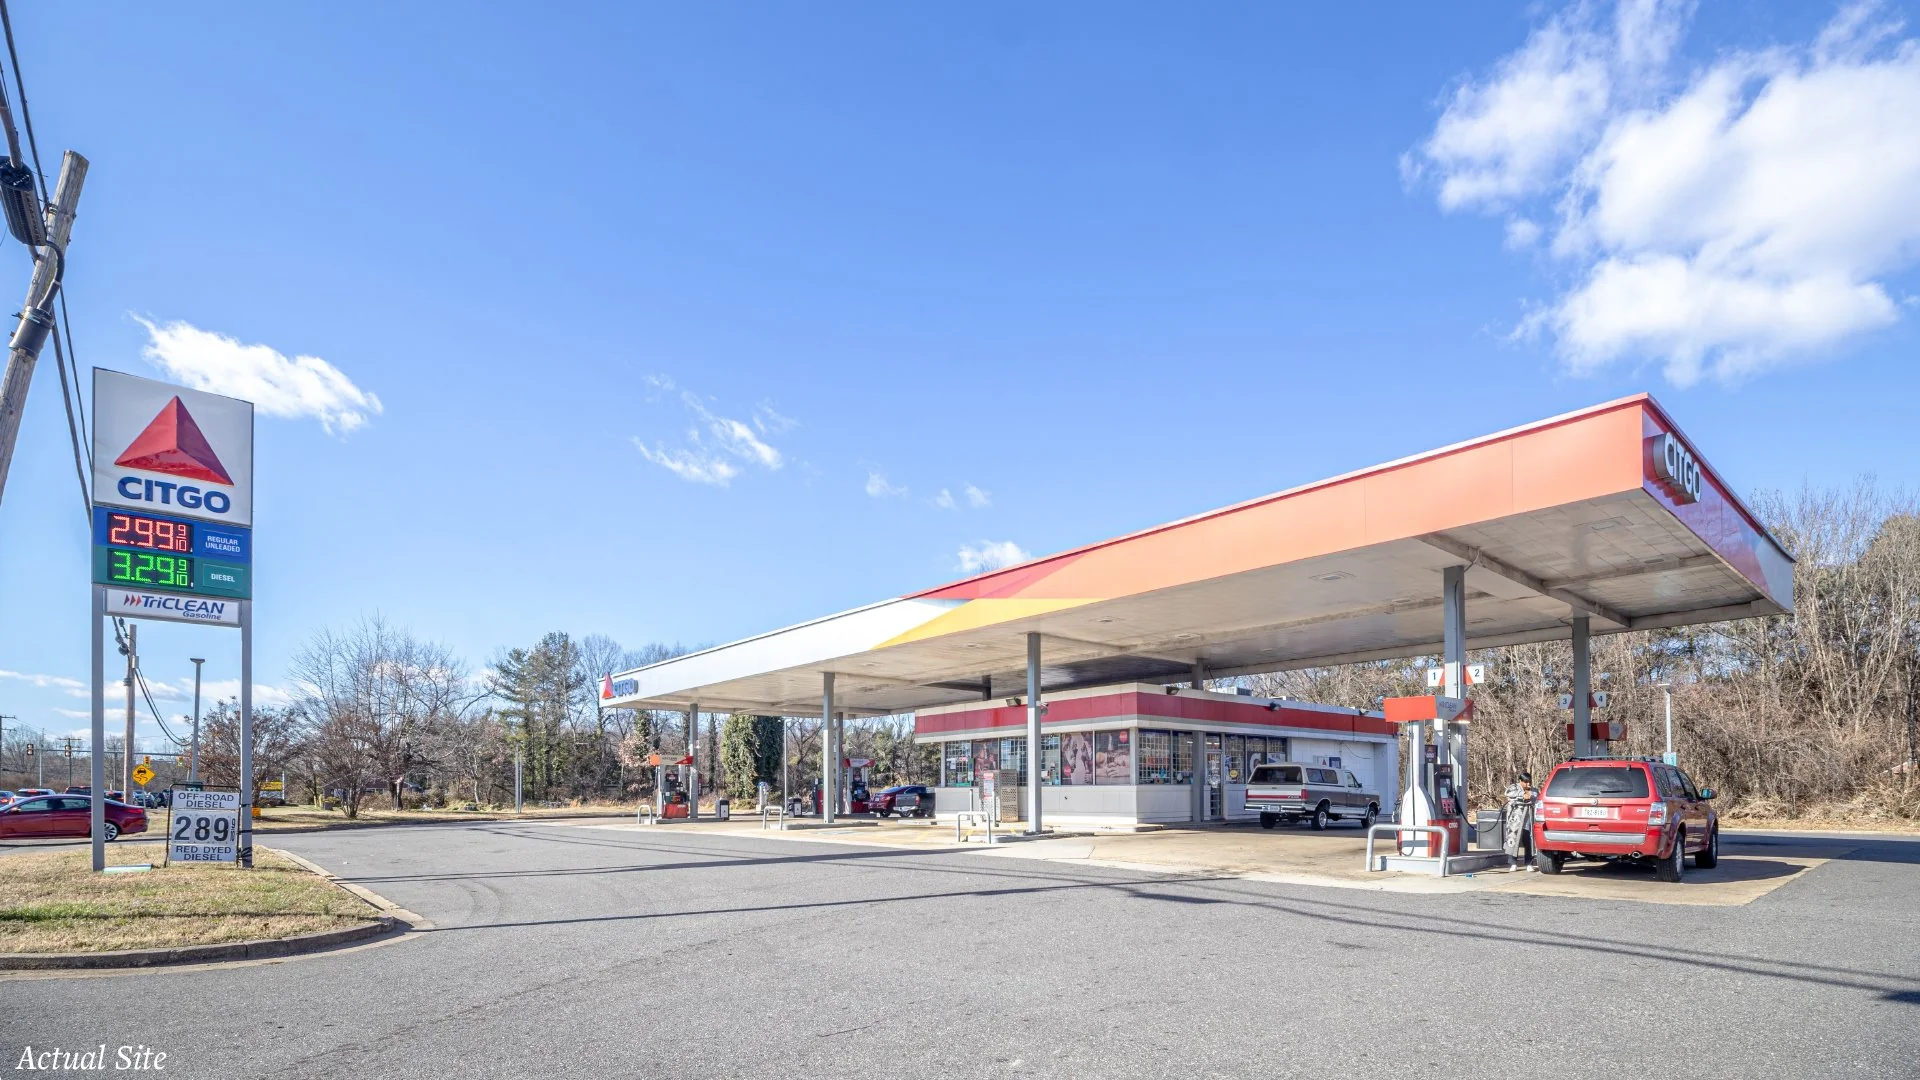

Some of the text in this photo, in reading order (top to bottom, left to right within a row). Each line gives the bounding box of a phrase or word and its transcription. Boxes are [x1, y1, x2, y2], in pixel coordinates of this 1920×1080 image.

[1664, 431, 1701, 503] CITGO
[117, 476, 231, 514] CITGO
[111, 515, 174, 550] 2.99
[207, 535, 239, 546] REGULAR
[205, 542, 241, 553] UNLEADED
[113, 551, 175, 585] 3.29
[210, 573, 236, 583] DIESEL
[141, 595, 225, 615] TriCLEAN
[182, 610, 222, 621] Gasoline
[1432, 672, 1437, 681] 1
[1474, 668, 1480, 677] 2
[1562, 697, 1568, 705] 3
[1598, 695, 1604, 703] 4
[178, 792, 235, 802] OFF-ROAD
[186, 800, 225, 809] DIESEL
[174, 815, 229, 842] 289
[175, 845, 232, 854] RED DYED
[183, 853, 223, 861] DIESEL
